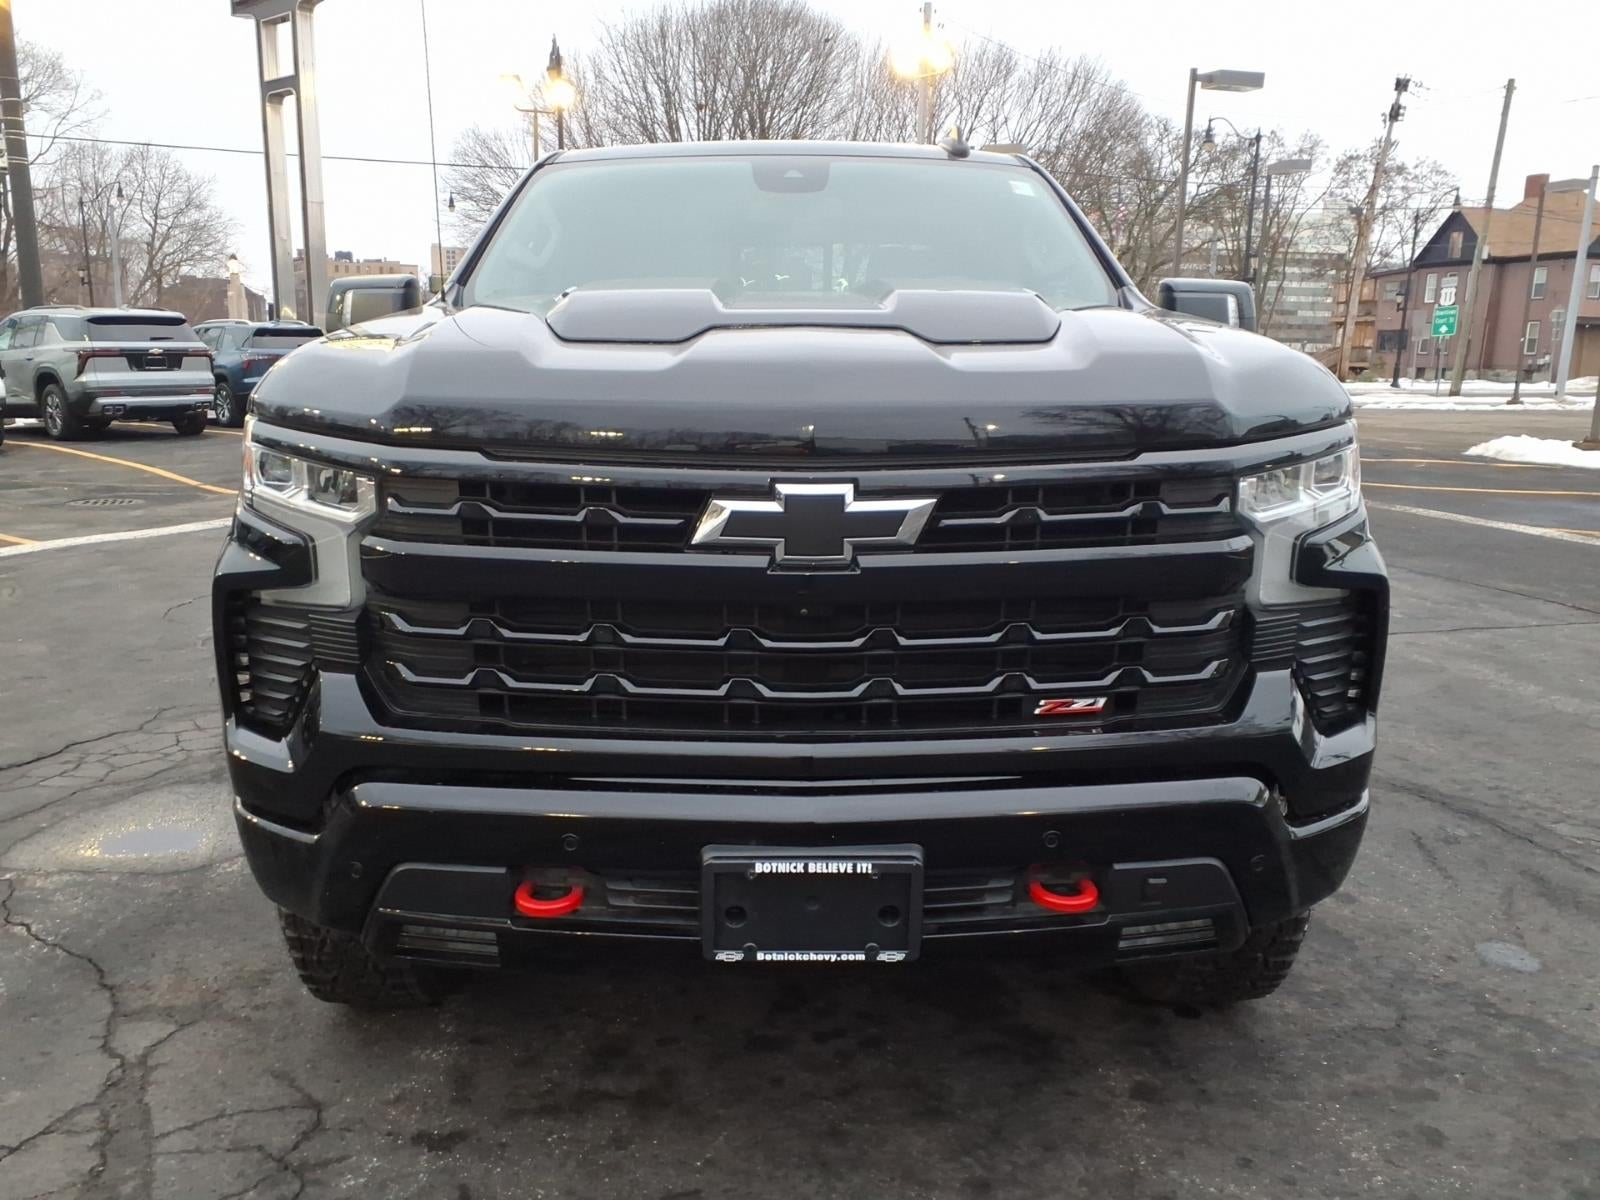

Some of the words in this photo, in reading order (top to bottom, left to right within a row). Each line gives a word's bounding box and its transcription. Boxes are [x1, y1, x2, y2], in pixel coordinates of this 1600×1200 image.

[1033, 696, 1108, 716] Z71
[754, 862, 804, 874] BOTNICK
[807, 862, 854, 874] BELIEVE
[856, 862, 872, 874] IT!
